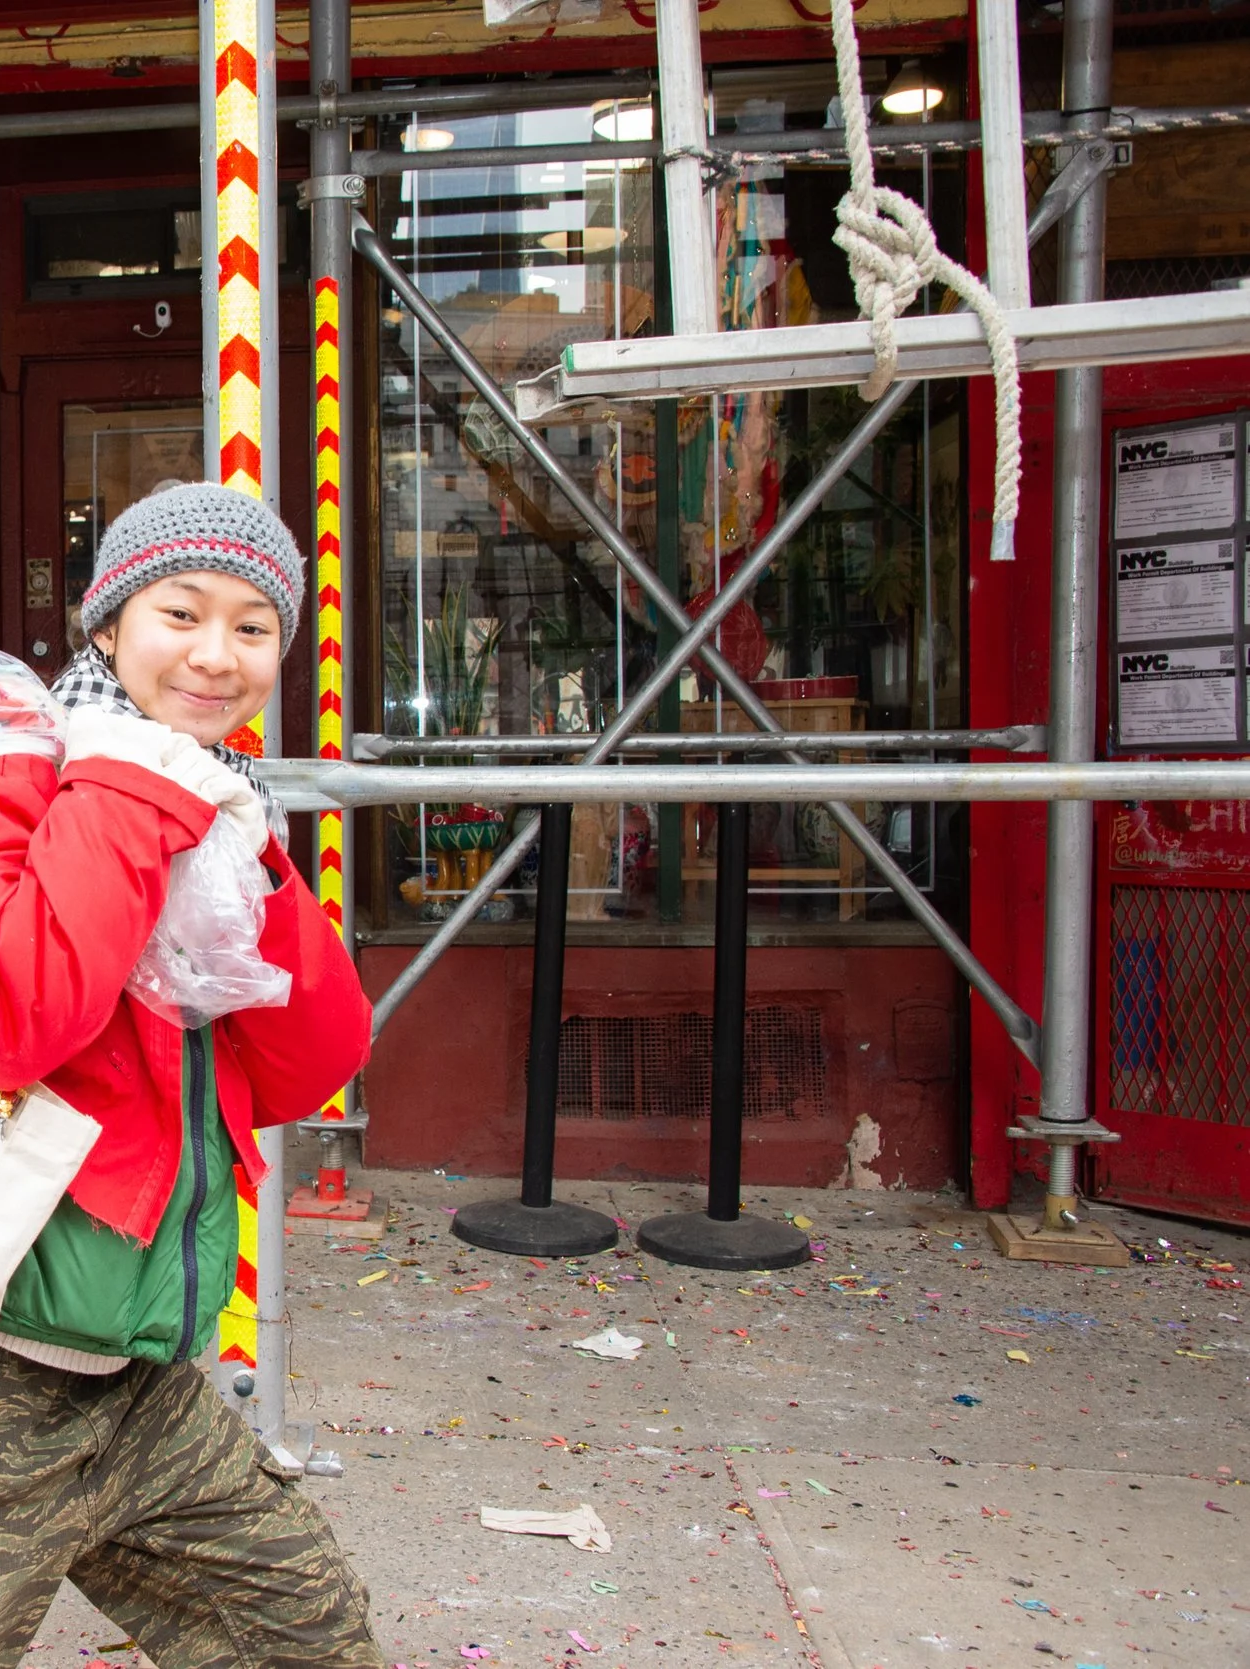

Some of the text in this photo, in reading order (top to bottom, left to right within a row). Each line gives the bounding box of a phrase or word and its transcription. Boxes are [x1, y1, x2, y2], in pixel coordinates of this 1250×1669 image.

[1121, 441, 1168, 463] NYC
[1160, 458, 1191, 467] Department
[1201, 453, 1226, 461] Buildings
[1121, 550, 1167, 570] NYC
[1160, 567, 1191, 575] Department
[1200, 564, 1225, 572] Buildings
[1122, 654, 1169, 673] NYC
[1162, 671, 1193, 679] Department
